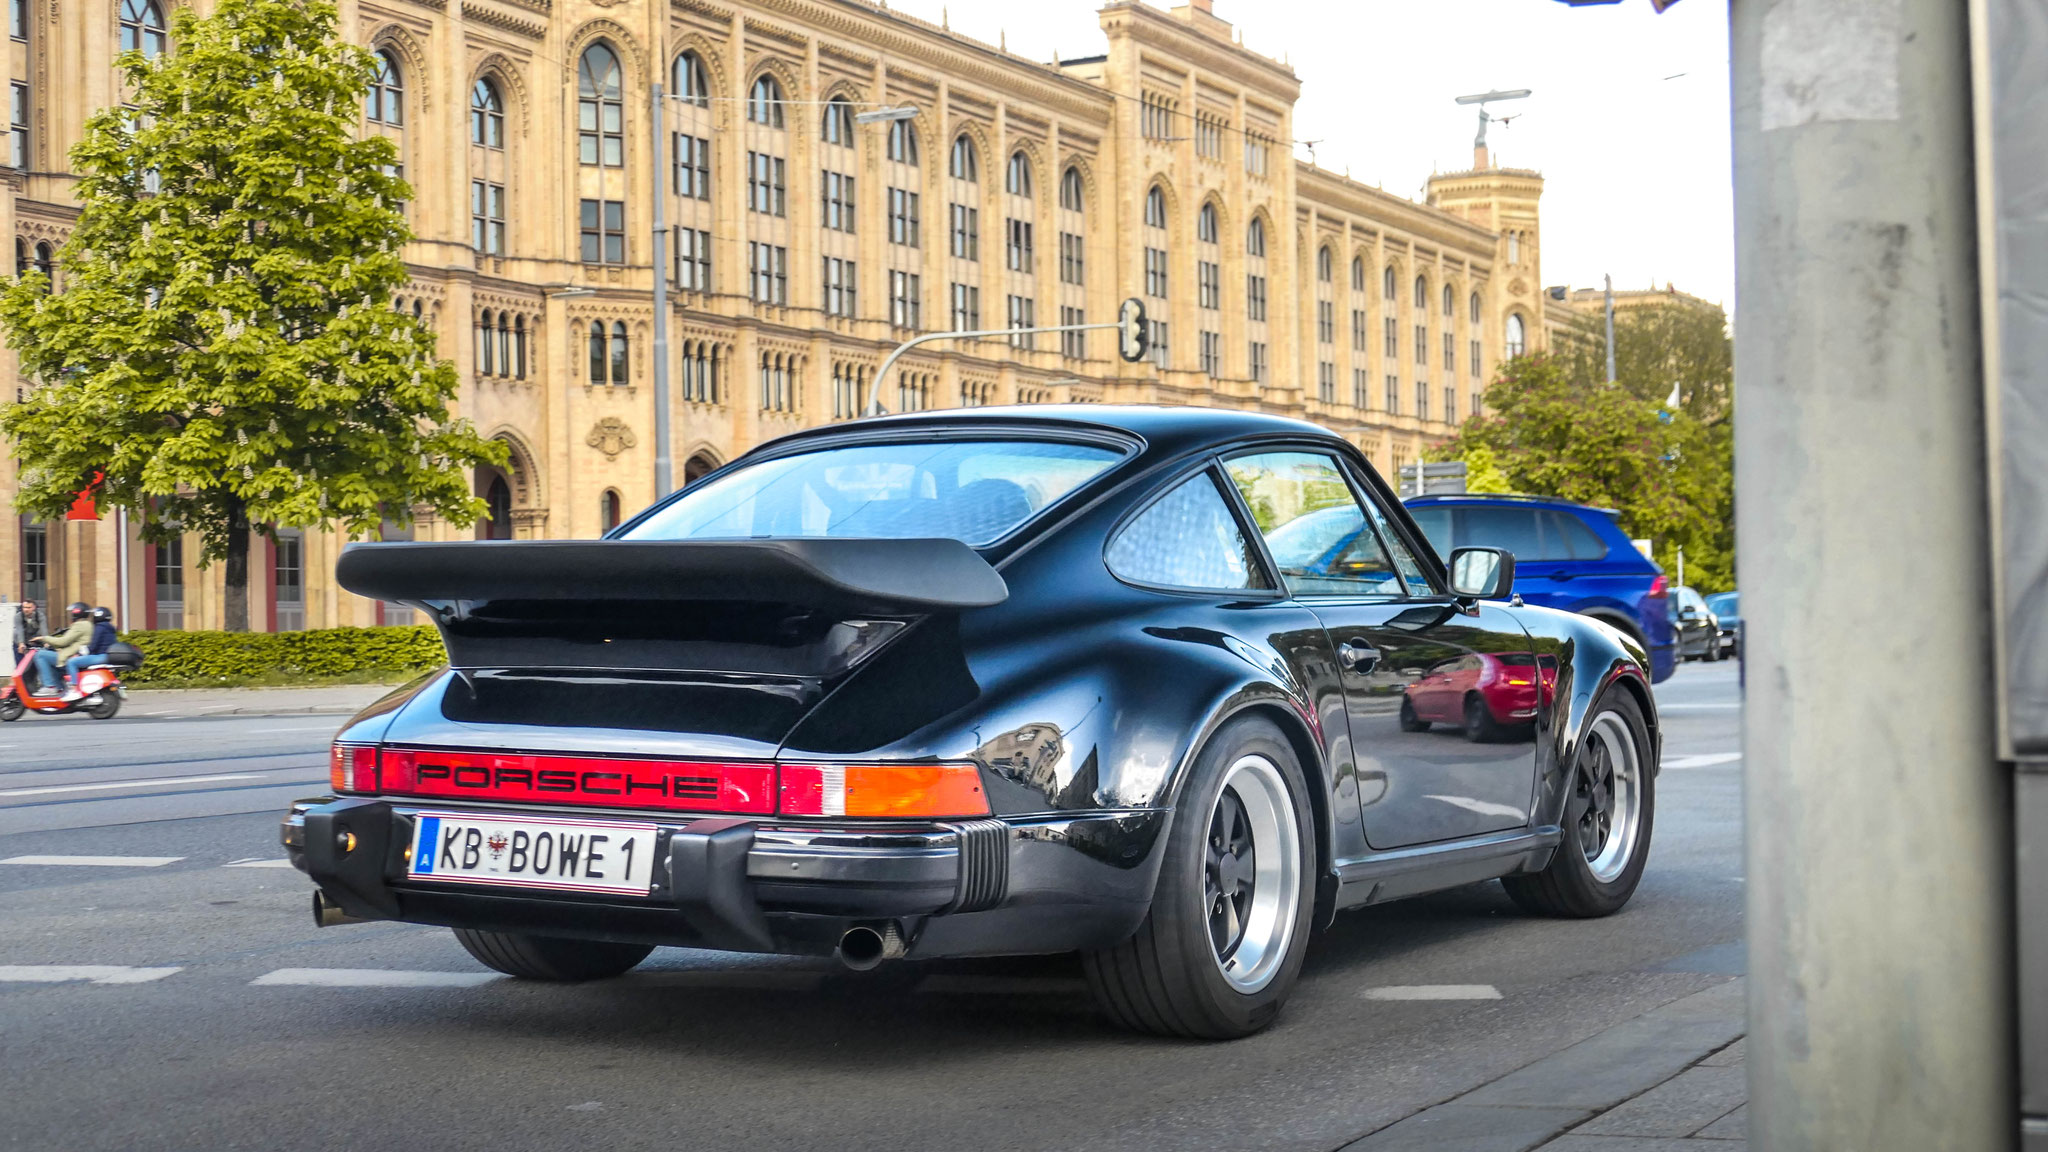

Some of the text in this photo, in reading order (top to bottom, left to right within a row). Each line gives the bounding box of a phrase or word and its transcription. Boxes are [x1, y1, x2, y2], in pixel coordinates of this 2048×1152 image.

[417, 764, 718, 800] PORSCHE
[420, 853, 430, 867] A
[440, 826, 635, 881] KB BOWE 1
